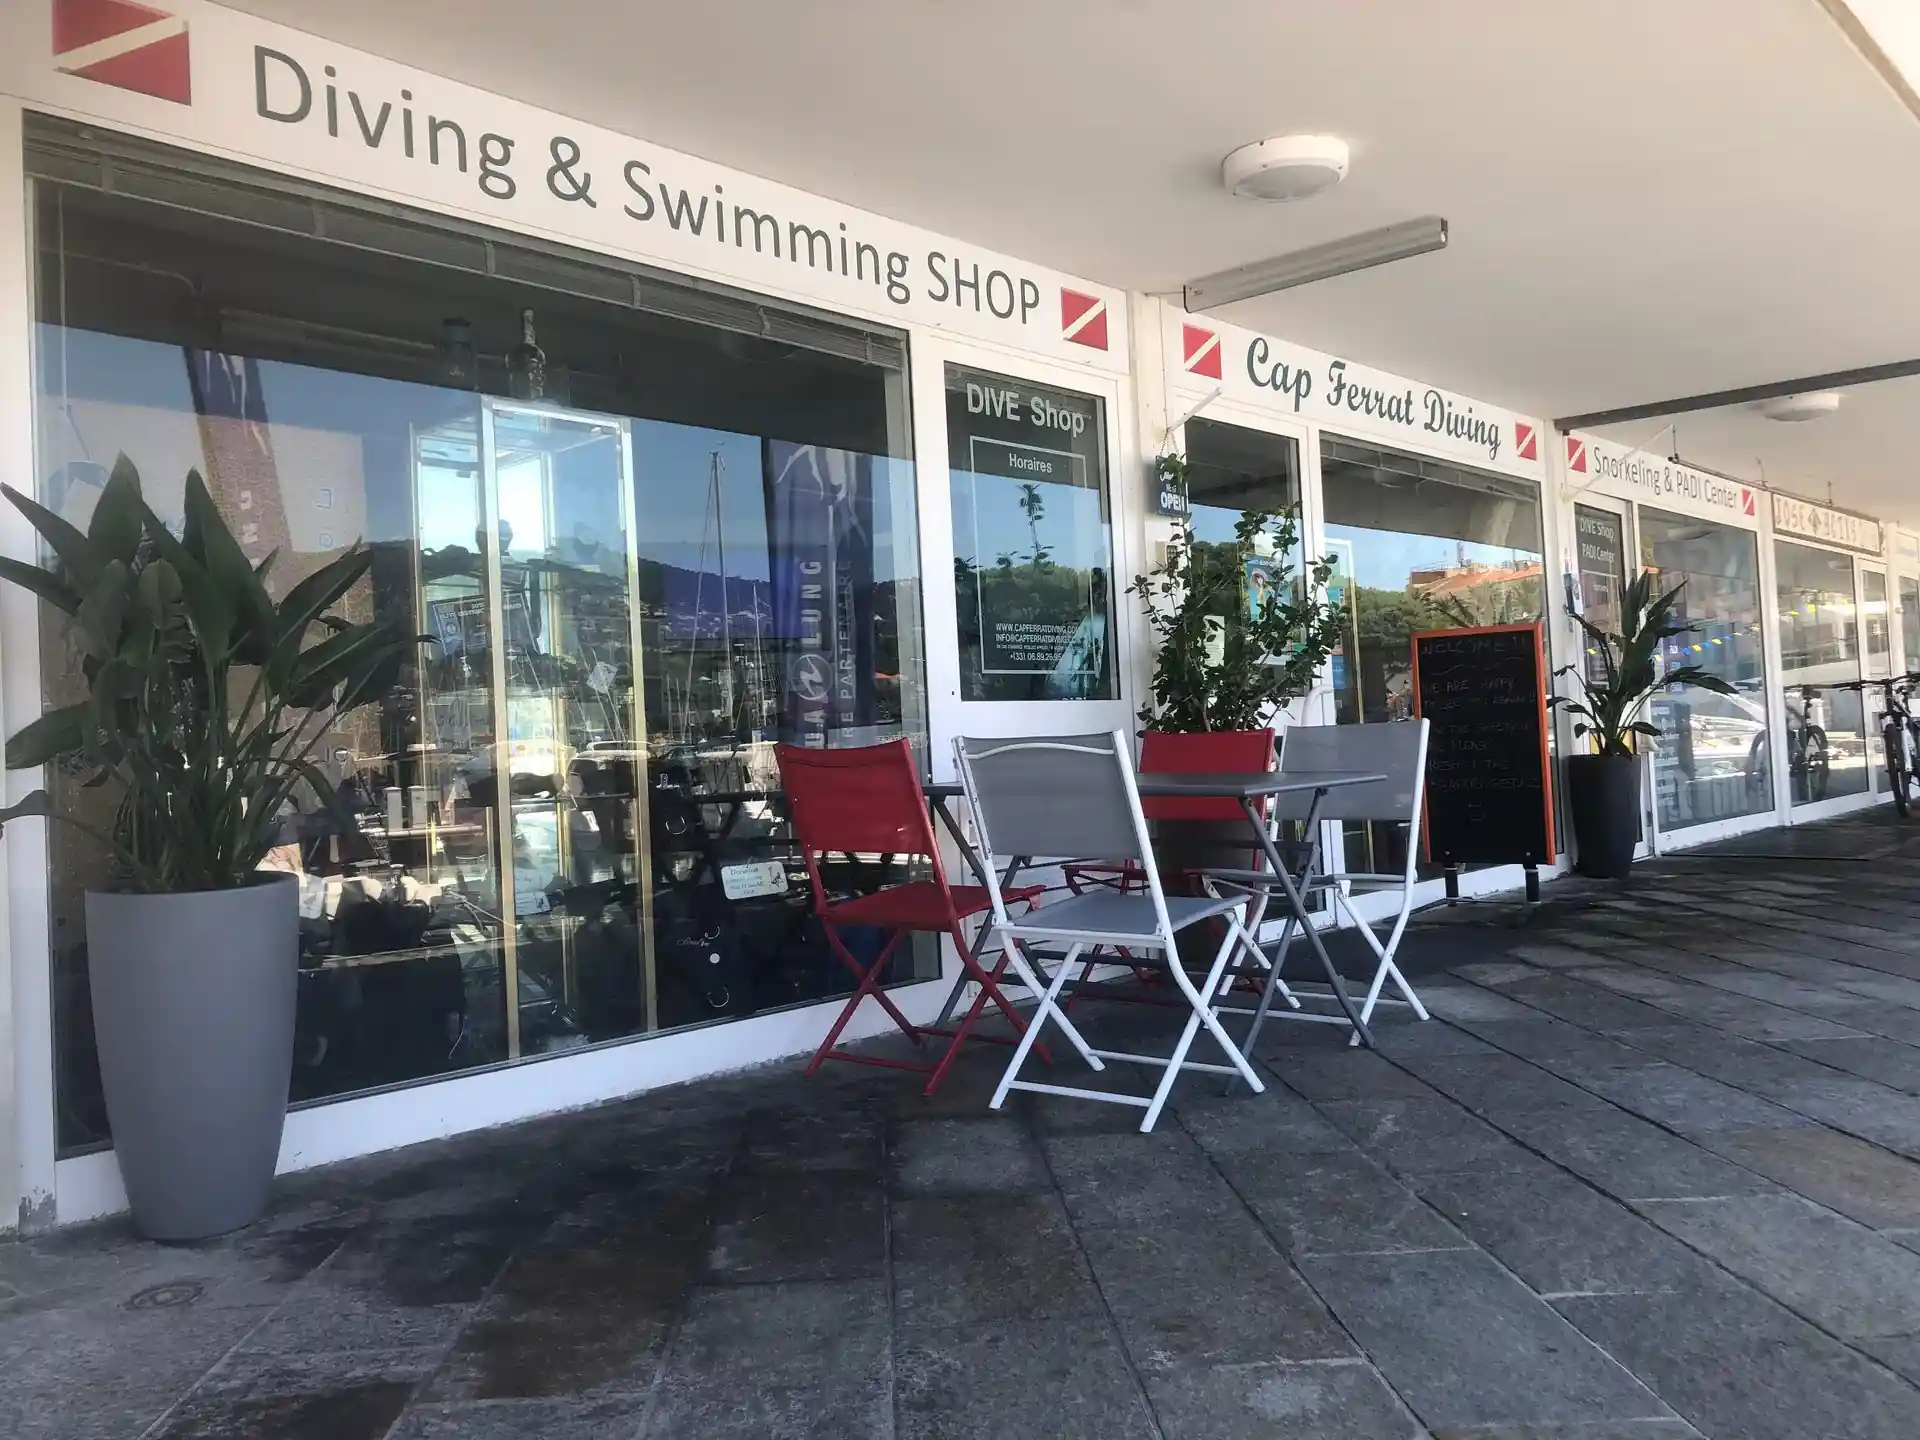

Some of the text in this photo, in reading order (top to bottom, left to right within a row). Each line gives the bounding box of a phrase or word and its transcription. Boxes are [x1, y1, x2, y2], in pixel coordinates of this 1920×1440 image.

[254, 45, 1041, 325] Diving & Swimming SHOP
[966, 382, 1085, 438] DIVE Shop
[1246, 337, 1502, 461] Cap Ferrat Diving
[1008, 452, 1053, 474] Horaires
[1593, 446, 1738, 509] Snorkeling & PADI Center
[1160, 491, 1185, 511] OPEN
[1582, 543, 1597, 560] PADI
[800, 561, 822, 648] LUNG
